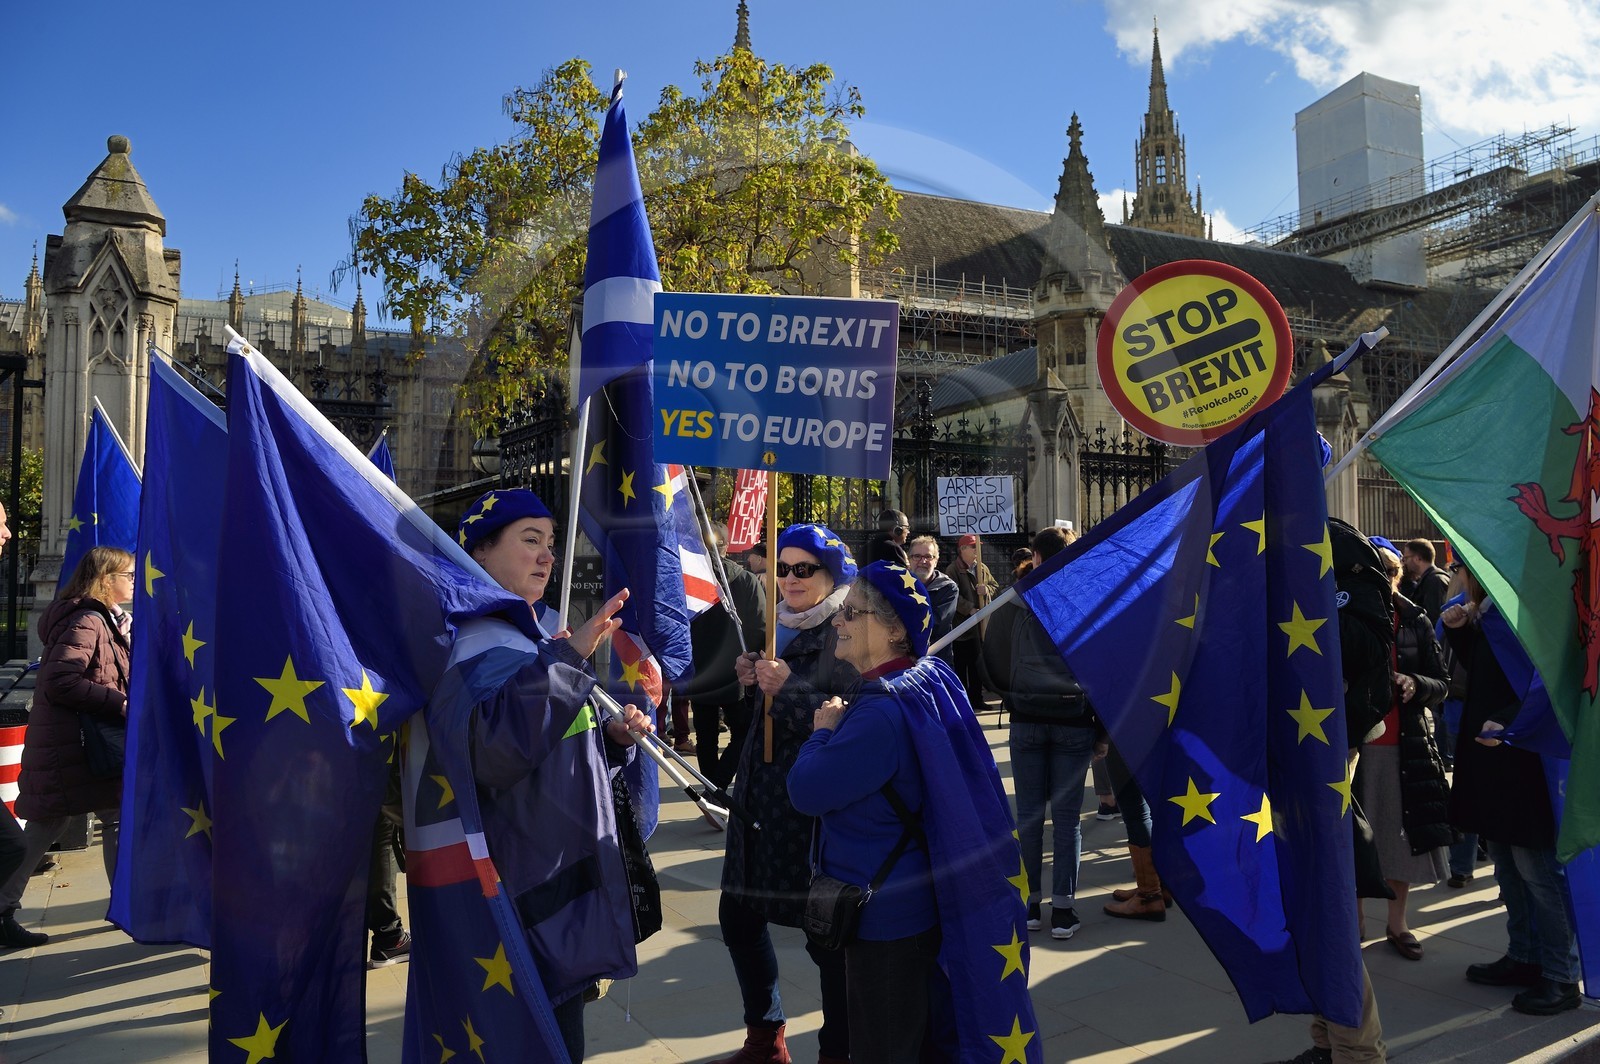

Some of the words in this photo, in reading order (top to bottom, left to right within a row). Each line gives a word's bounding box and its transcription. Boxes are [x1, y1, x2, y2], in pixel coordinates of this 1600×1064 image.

[660, 309, 708, 339] NO
[717, 311, 760, 342] TO
[767, 314, 890, 349] BREXIT
[1123, 288, 1238, 357] STOP
[667, 359, 715, 390] NO
[724, 362, 768, 393] TO
[775, 365, 878, 400] BORIS
[1142, 340, 1267, 414] BREXIT
[1182, 387, 1249, 419] #RevokeA50
[660, 409, 714, 439] YES
[719, 412, 760, 443] TO
[763, 415, 886, 451] EUROPE
[1181, 413, 1237, 429] StopBrexitSteve.org
[741, 469, 768, 492] LEAVE
[945, 476, 1008, 495] ARREST
[732, 490, 767, 519] MEANS
[938, 495, 1006, 515] SPEAKER
[730, 516, 763, 545] LEAVE
[946, 514, 1014, 534] BERCOW
[571, 582, 582, 590] NO
[583, 582, 604, 590] ENTR
